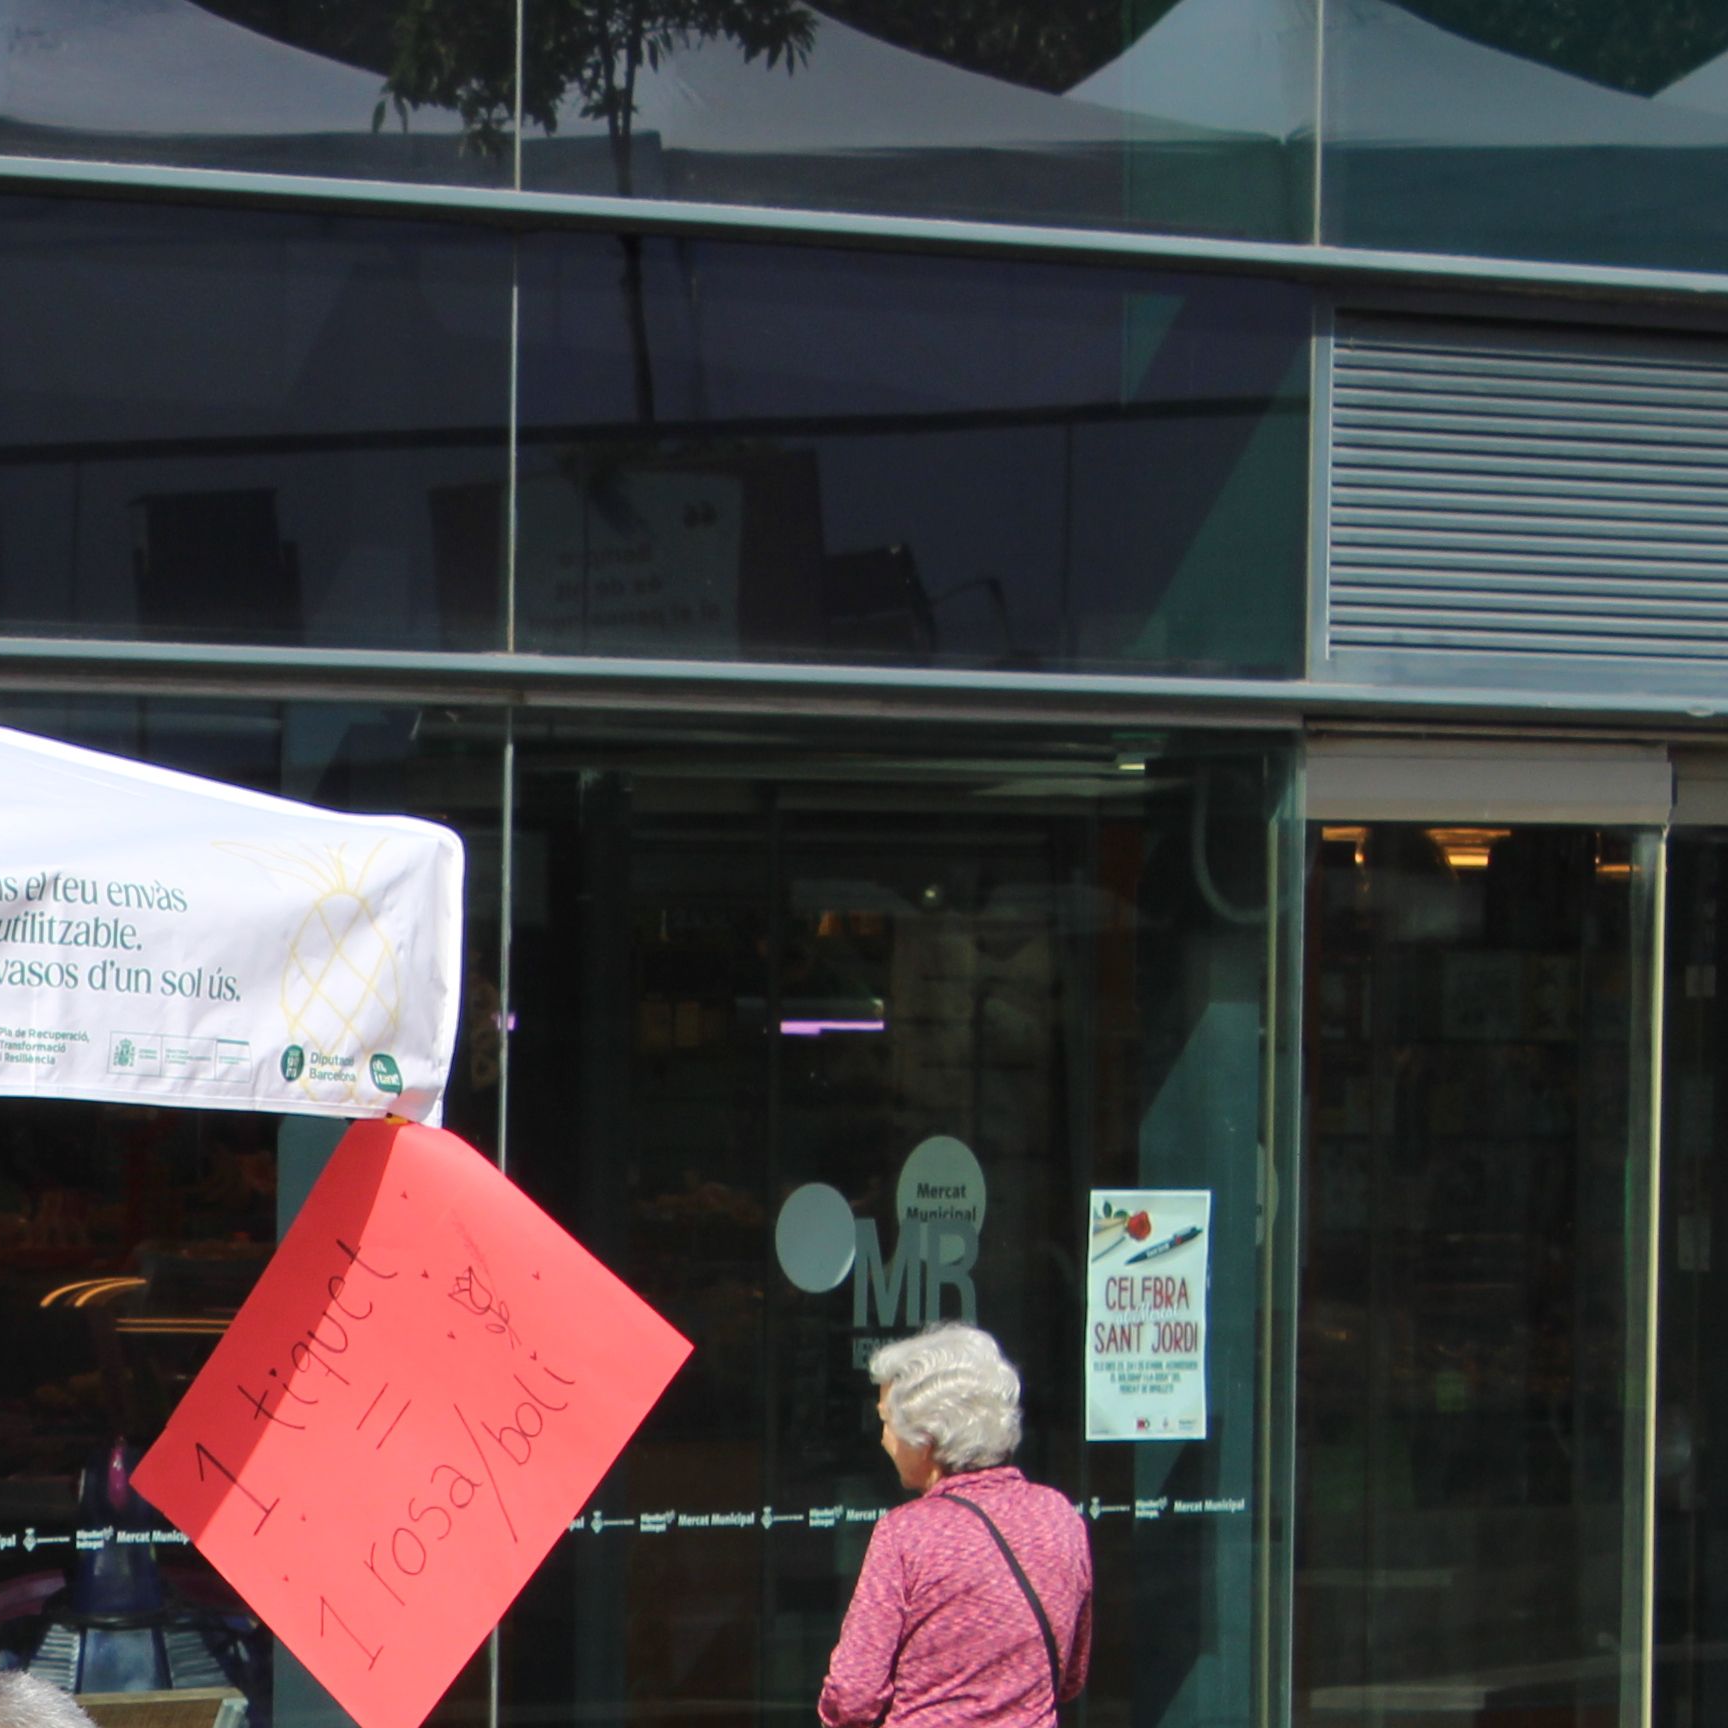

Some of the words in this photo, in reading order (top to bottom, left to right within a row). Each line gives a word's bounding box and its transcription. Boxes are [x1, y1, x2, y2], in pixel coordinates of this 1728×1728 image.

[52, 873, 98, 905] teu
[107, 881, 188, 913] envàs
[160, 967, 201, 999] sol
[207, 967, 242, 1002] ús.
[0, 1039, 66, 1052] Transformació
[917, 1183, 966, 1199] Mercat
[1105, 1276, 1190, 1311] CELEBRA
[1094, 1323, 1143, 1354] SANT
[1151, 1323, 1198, 1354] JORDI
[195, 1443, 280, 1536] 1
[678, 1514, 710, 1528] Mercat
[711, 1512, 755, 1527] Municipal
[846, 1508, 877, 1521] Mercat
[117, 1531, 150, 1543] Mercat
[152, 1530, 189, 1545] Municip
[319, 1596, 385, 1672] 1
